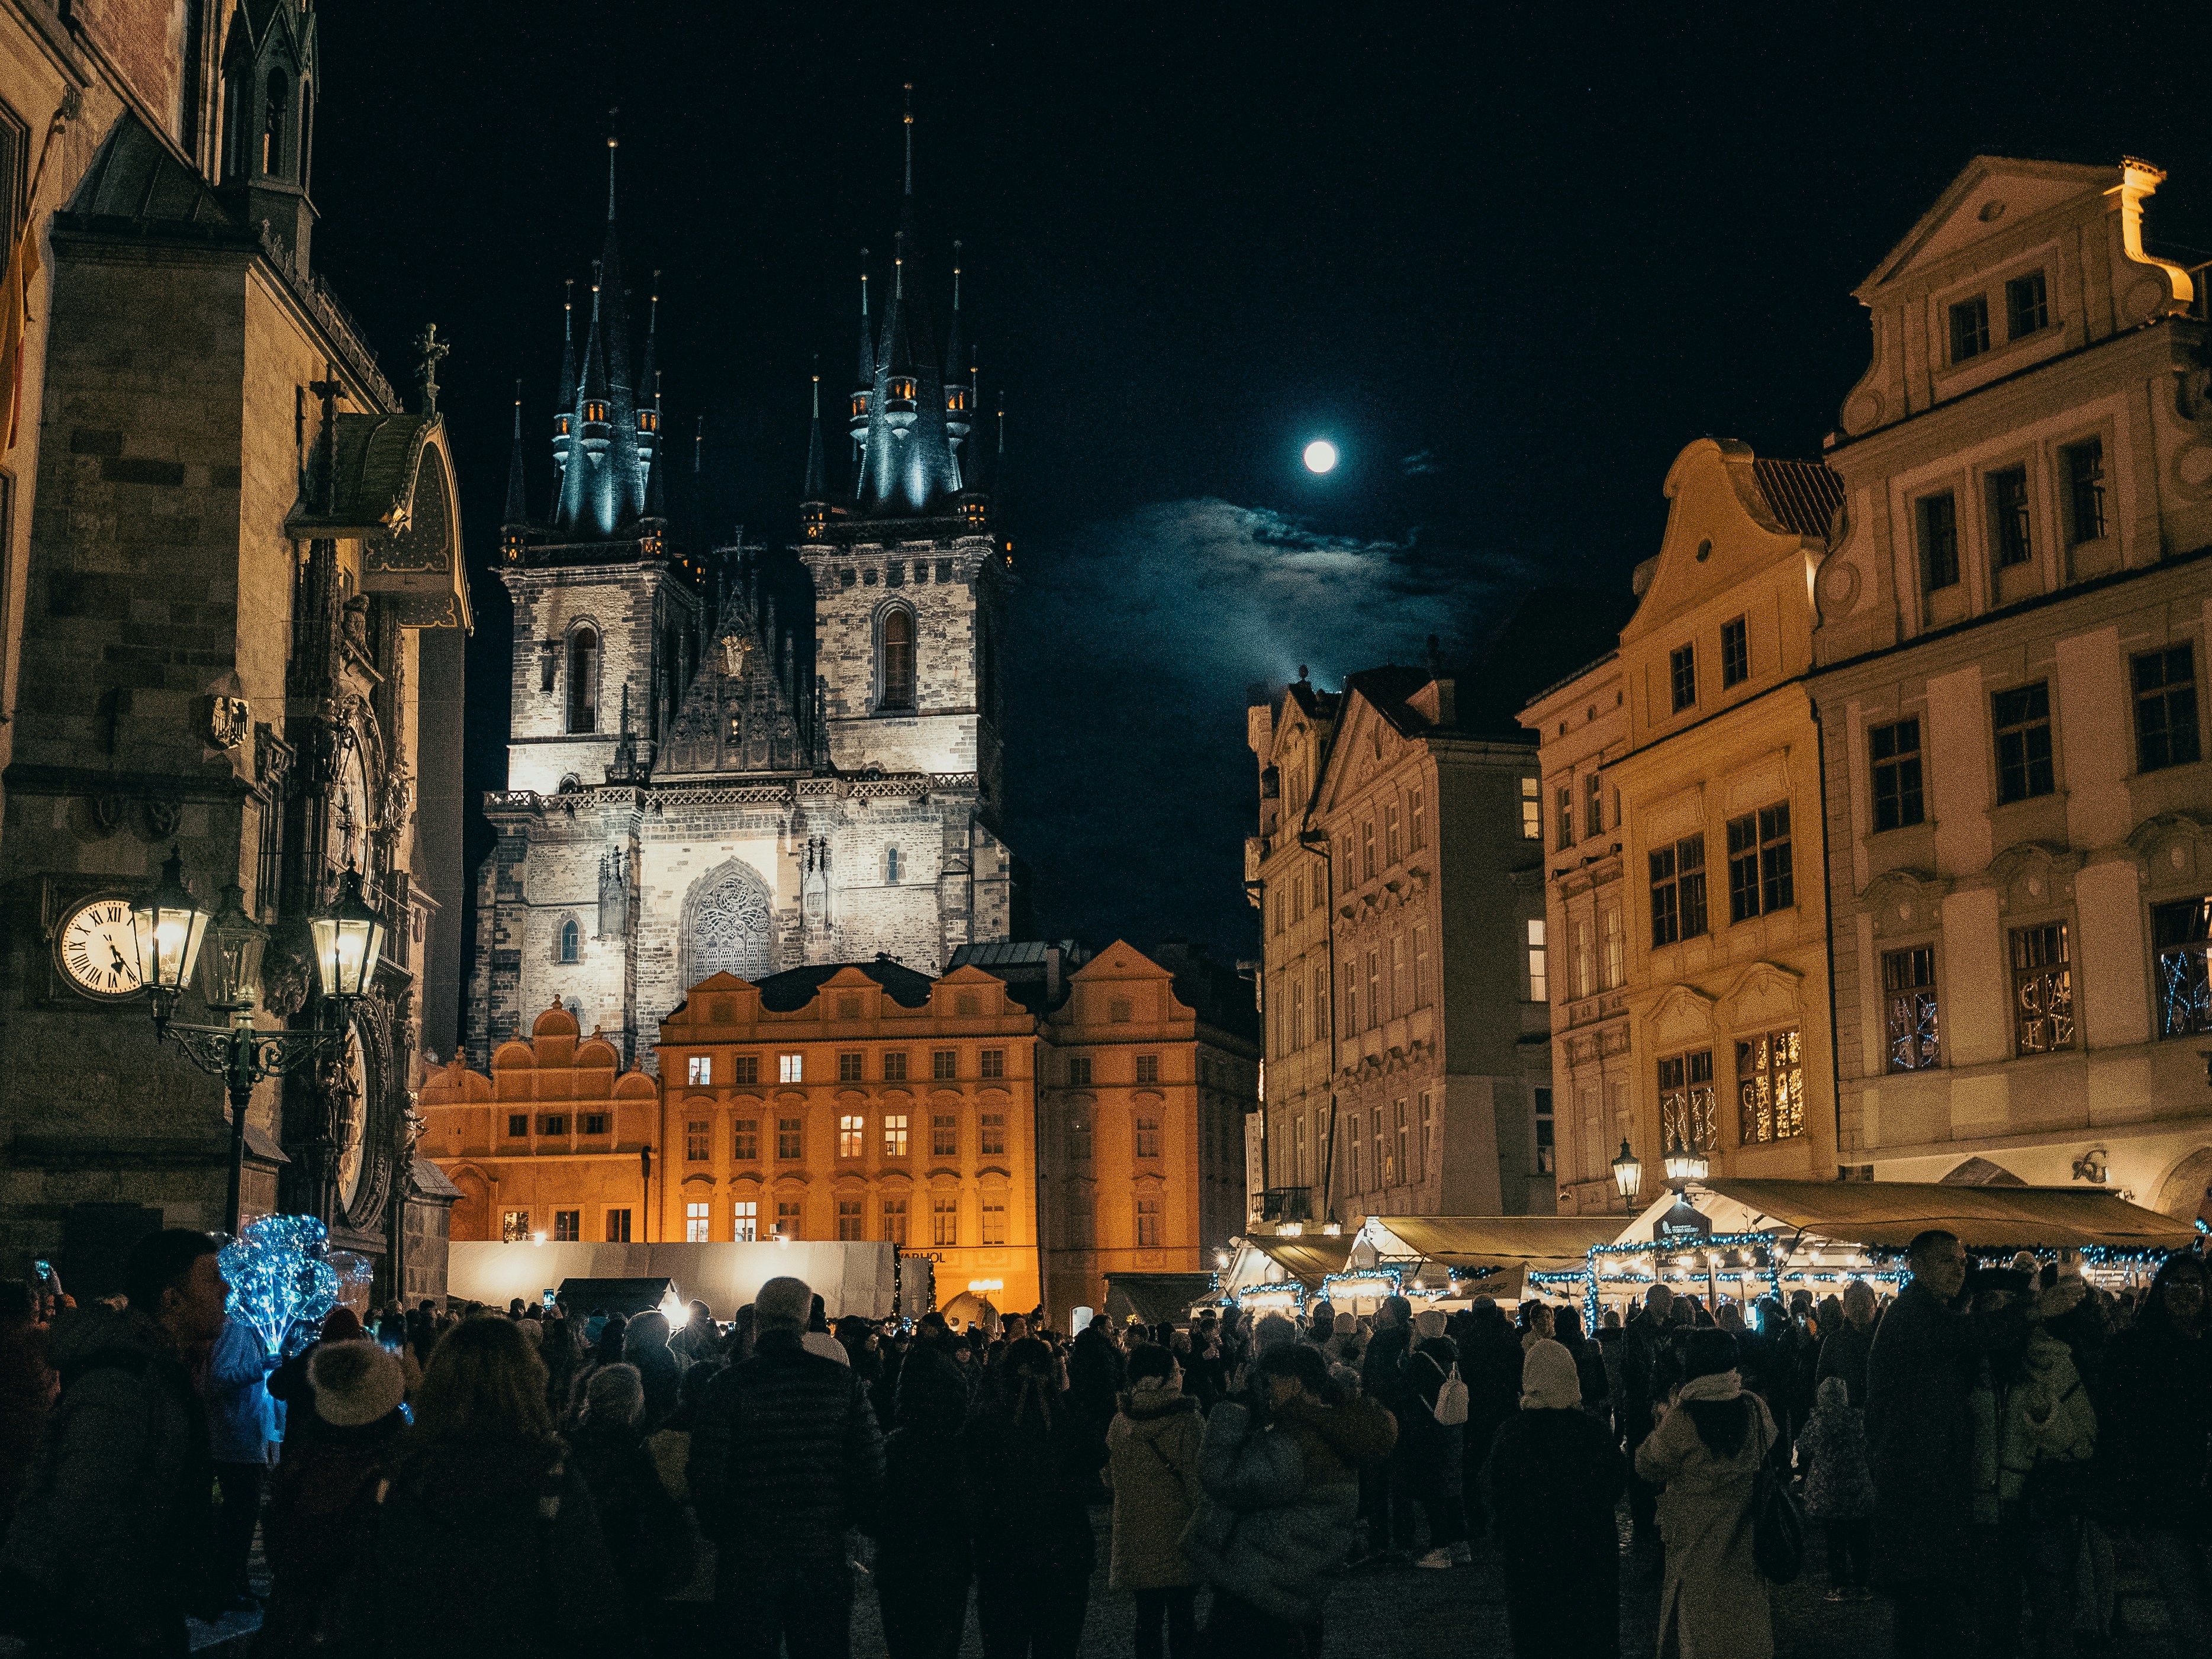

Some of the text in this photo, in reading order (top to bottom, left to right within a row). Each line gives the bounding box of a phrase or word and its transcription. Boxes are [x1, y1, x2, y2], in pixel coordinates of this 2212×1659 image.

[89, 910, 104, 927] XI
[107, 907, 121, 923] XII
[75, 924, 91, 936] X
[69, 940, 86, 950] IX
[71, 953, 91, 974] VIII
[85, 967, 102, 985] VII
[108, 972, 118, 987] VI
